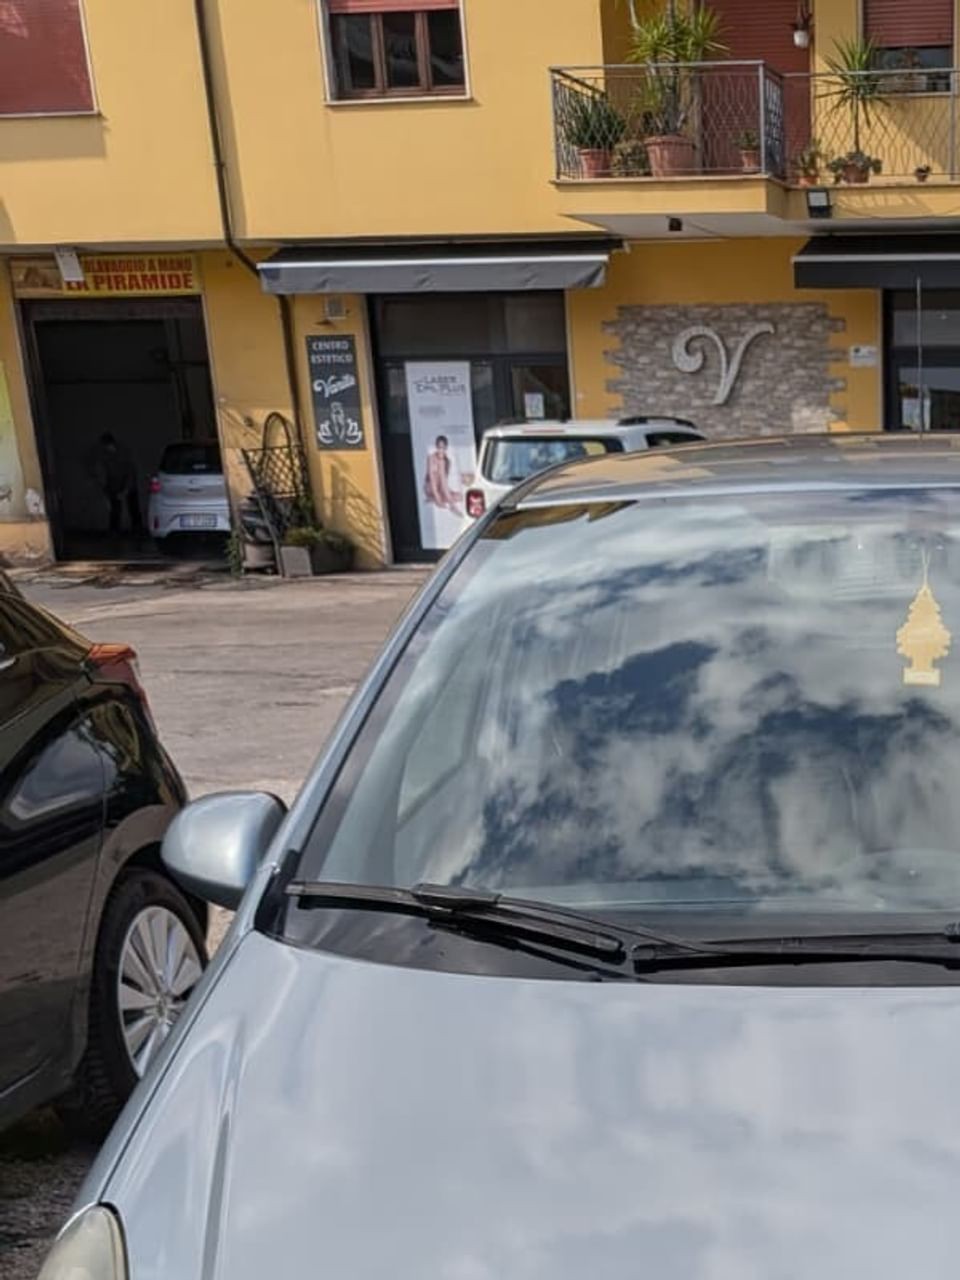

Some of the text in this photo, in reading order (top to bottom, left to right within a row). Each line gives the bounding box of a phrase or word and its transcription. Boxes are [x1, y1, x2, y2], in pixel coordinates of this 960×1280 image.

[93, 272, 193, 291] PIRAMIDE
[312, 340, 350, 351] CENTRO
[311, 353, 353, 364] ESTETICO
